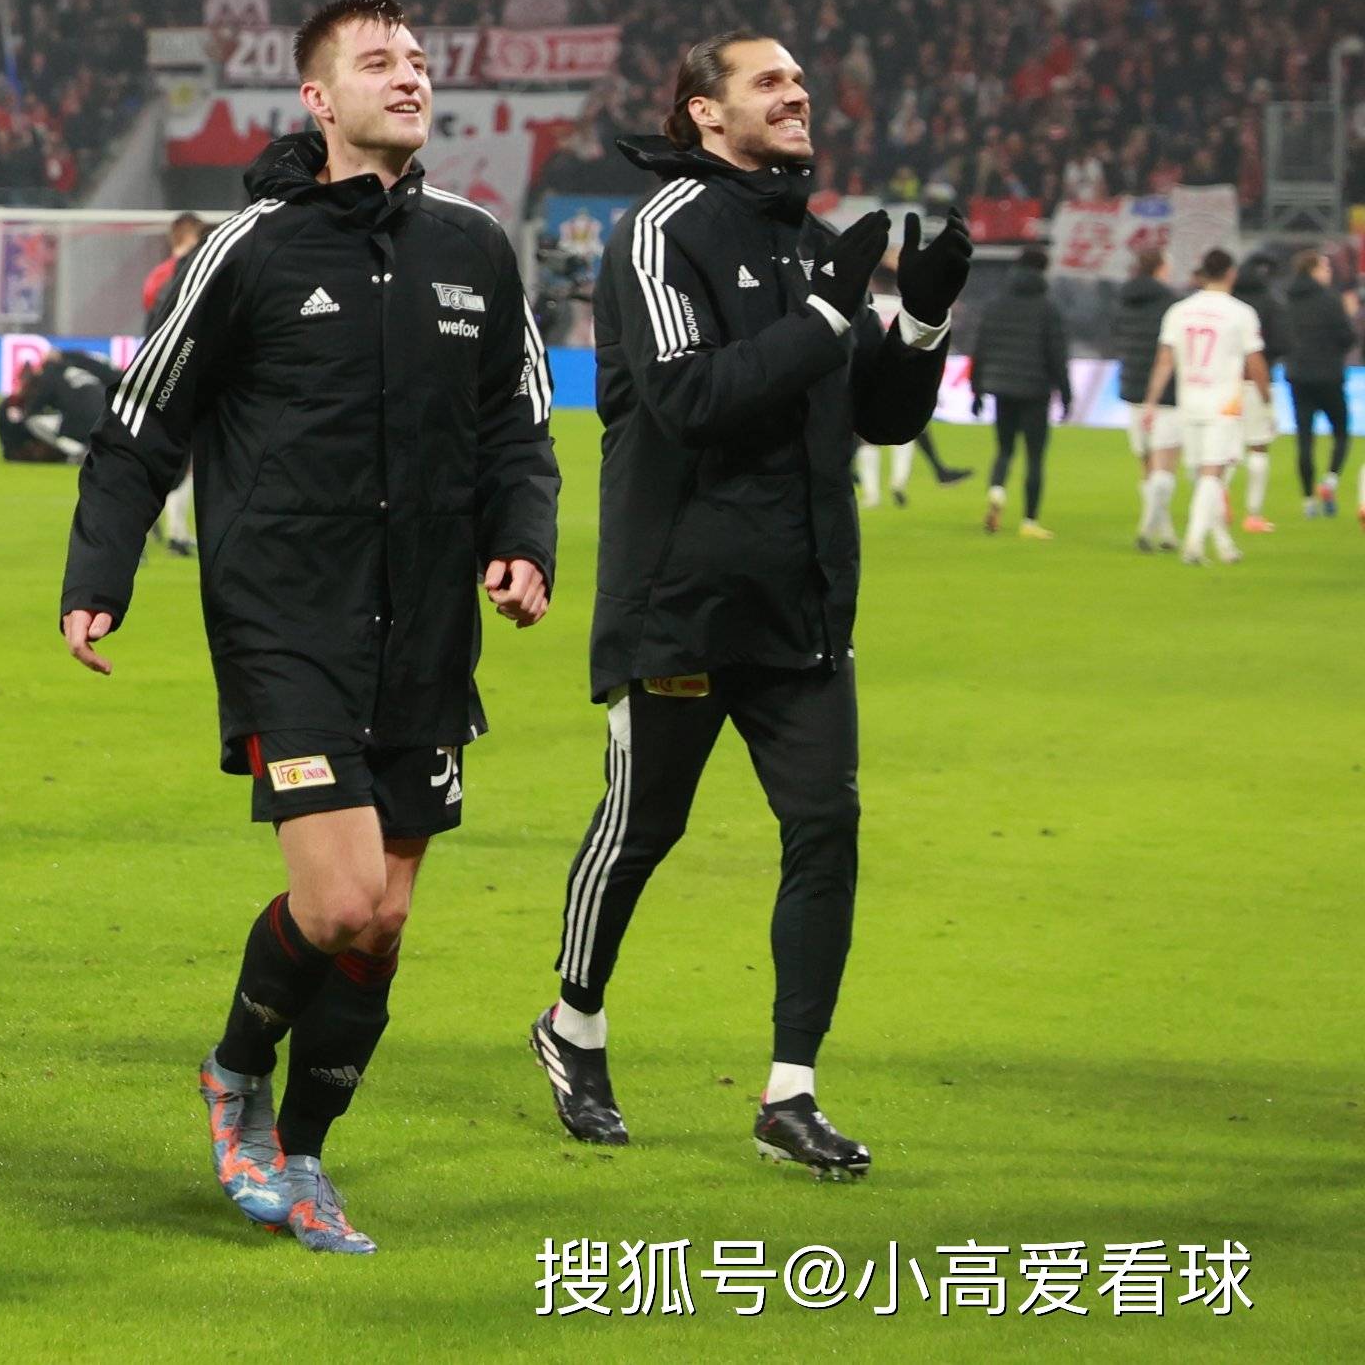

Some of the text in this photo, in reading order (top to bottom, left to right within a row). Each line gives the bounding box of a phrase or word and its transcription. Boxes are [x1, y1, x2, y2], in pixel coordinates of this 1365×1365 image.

[300, 302, 340, 316] adidas
[438, 318, 479, 338] wefox
[1183, 325, 1218, 368] 17
[155, 337, 196, 412] AROUNDTOWN
